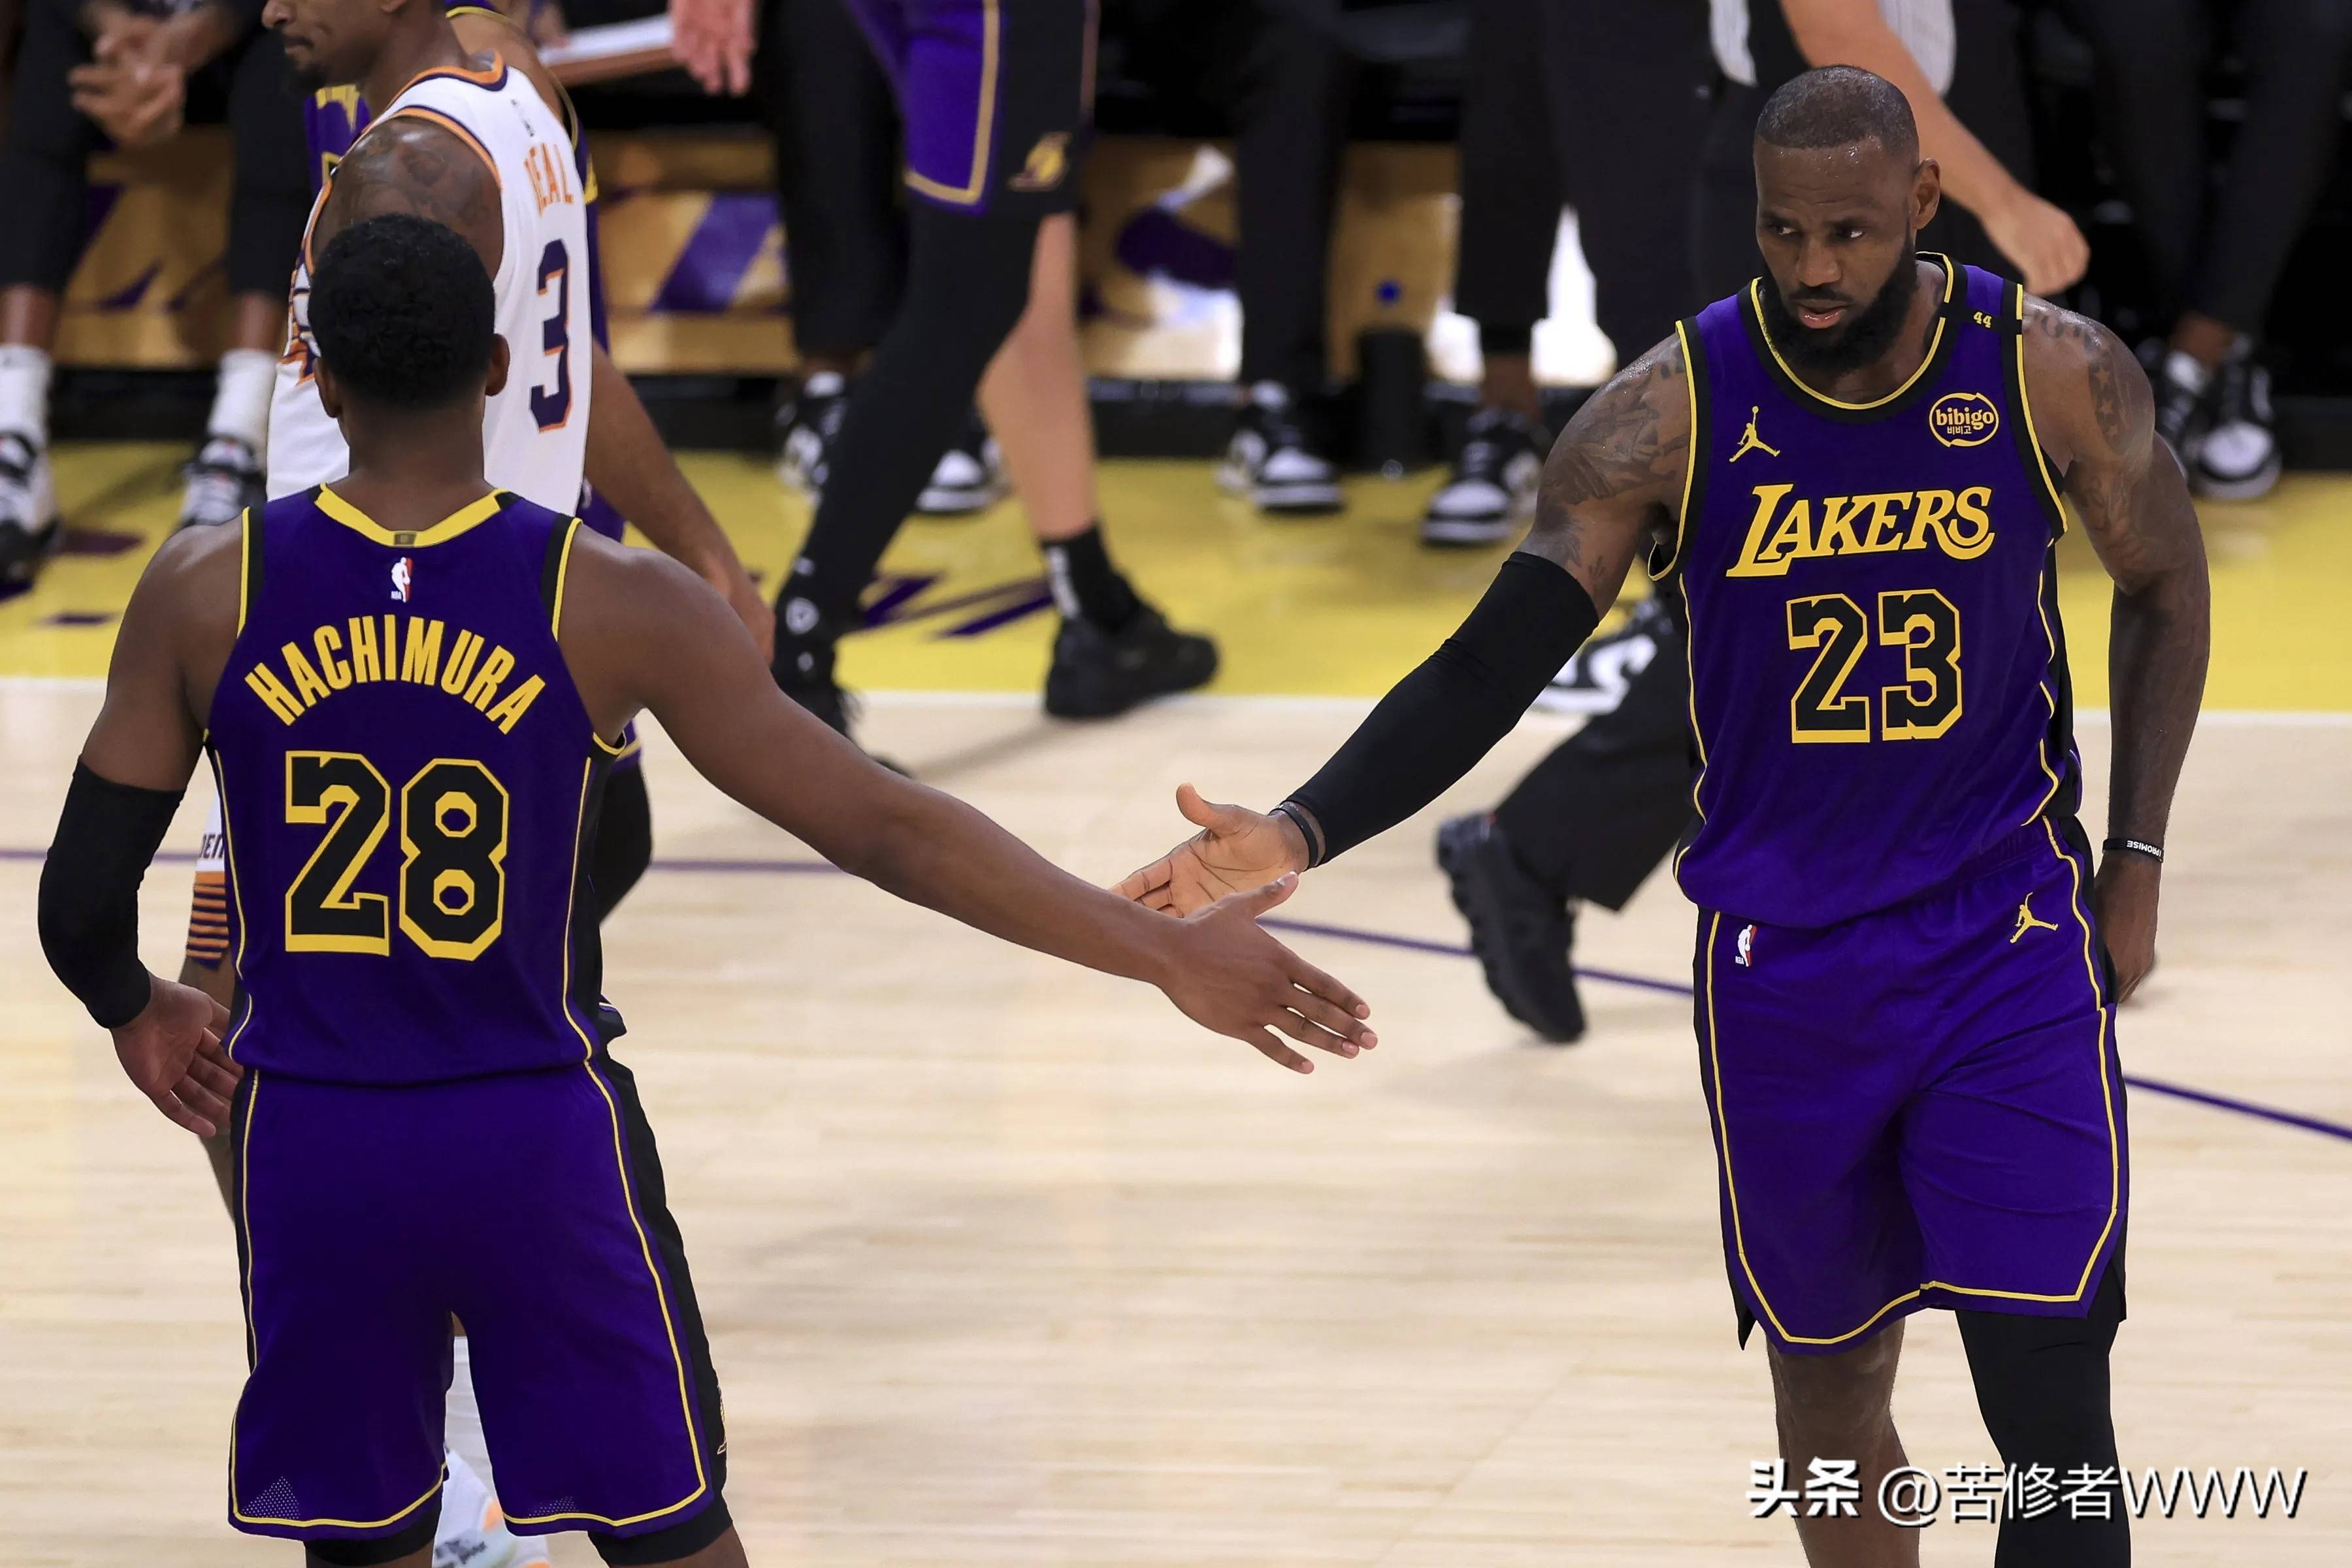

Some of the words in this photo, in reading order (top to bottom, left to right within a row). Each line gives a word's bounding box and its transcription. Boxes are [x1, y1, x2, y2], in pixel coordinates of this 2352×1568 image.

[524, 142, 574, 217] EAL
[529, 238, 572, 433] 3
[1973, 311, 1992, 328] 44
[1936, 407, 1995, 431] bibigo
[1947, 425, 1972, 435] 비비고
[1725, 483, 1995, 577] LAKERS
[244, 614, 546, 735] HACHIMURA
[1786, 589, 1963, 744] 23
[286, 751, 509, 961] 28
